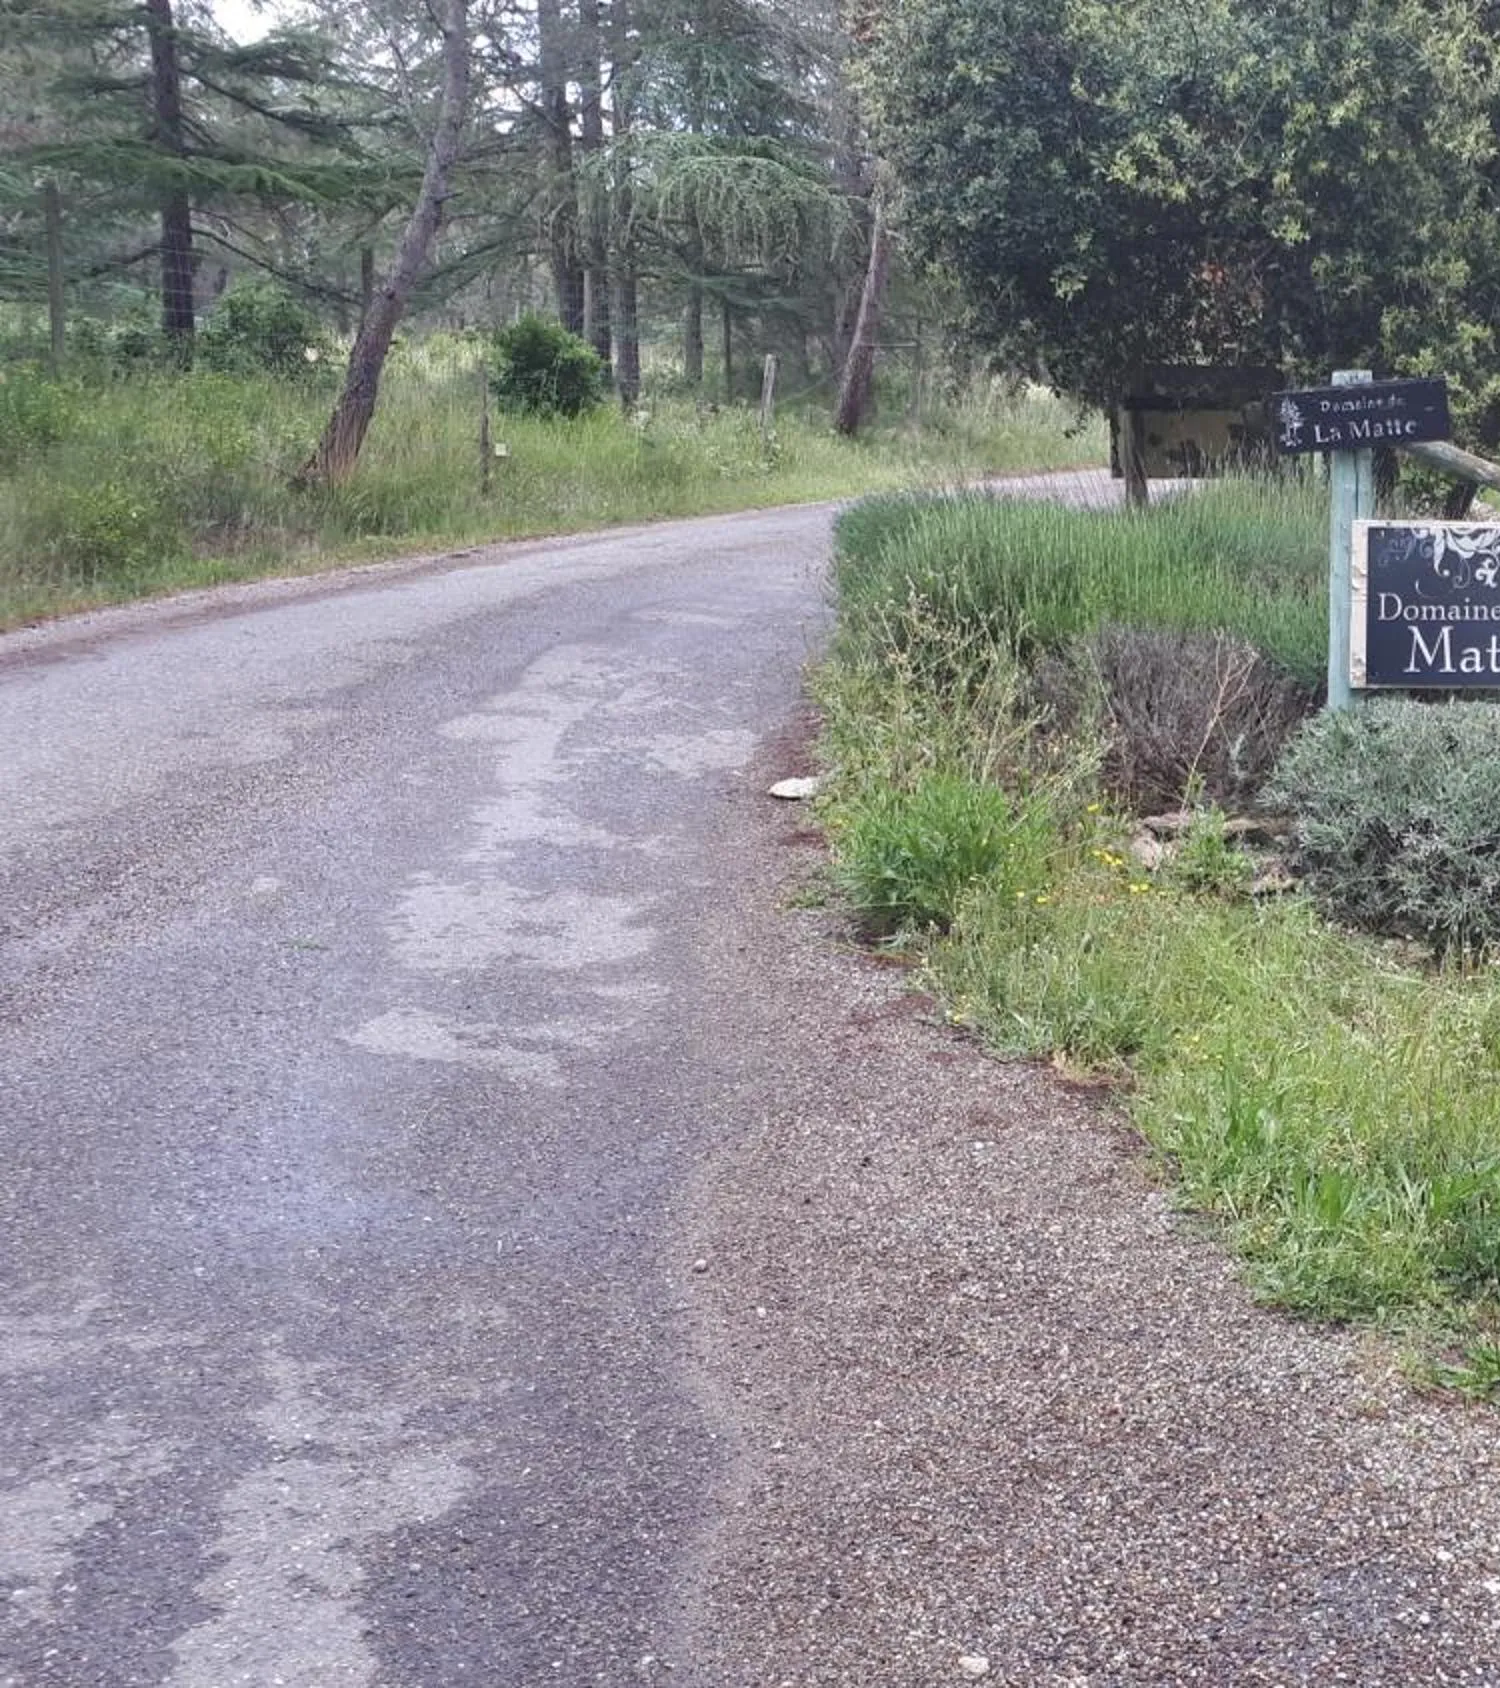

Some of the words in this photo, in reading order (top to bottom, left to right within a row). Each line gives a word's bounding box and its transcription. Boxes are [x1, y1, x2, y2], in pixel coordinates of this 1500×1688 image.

[1319, 396, 1384, 413] Domaine
[1314, 424, 1342, 443] La
[1349, 418, 1418, 439] Matte
